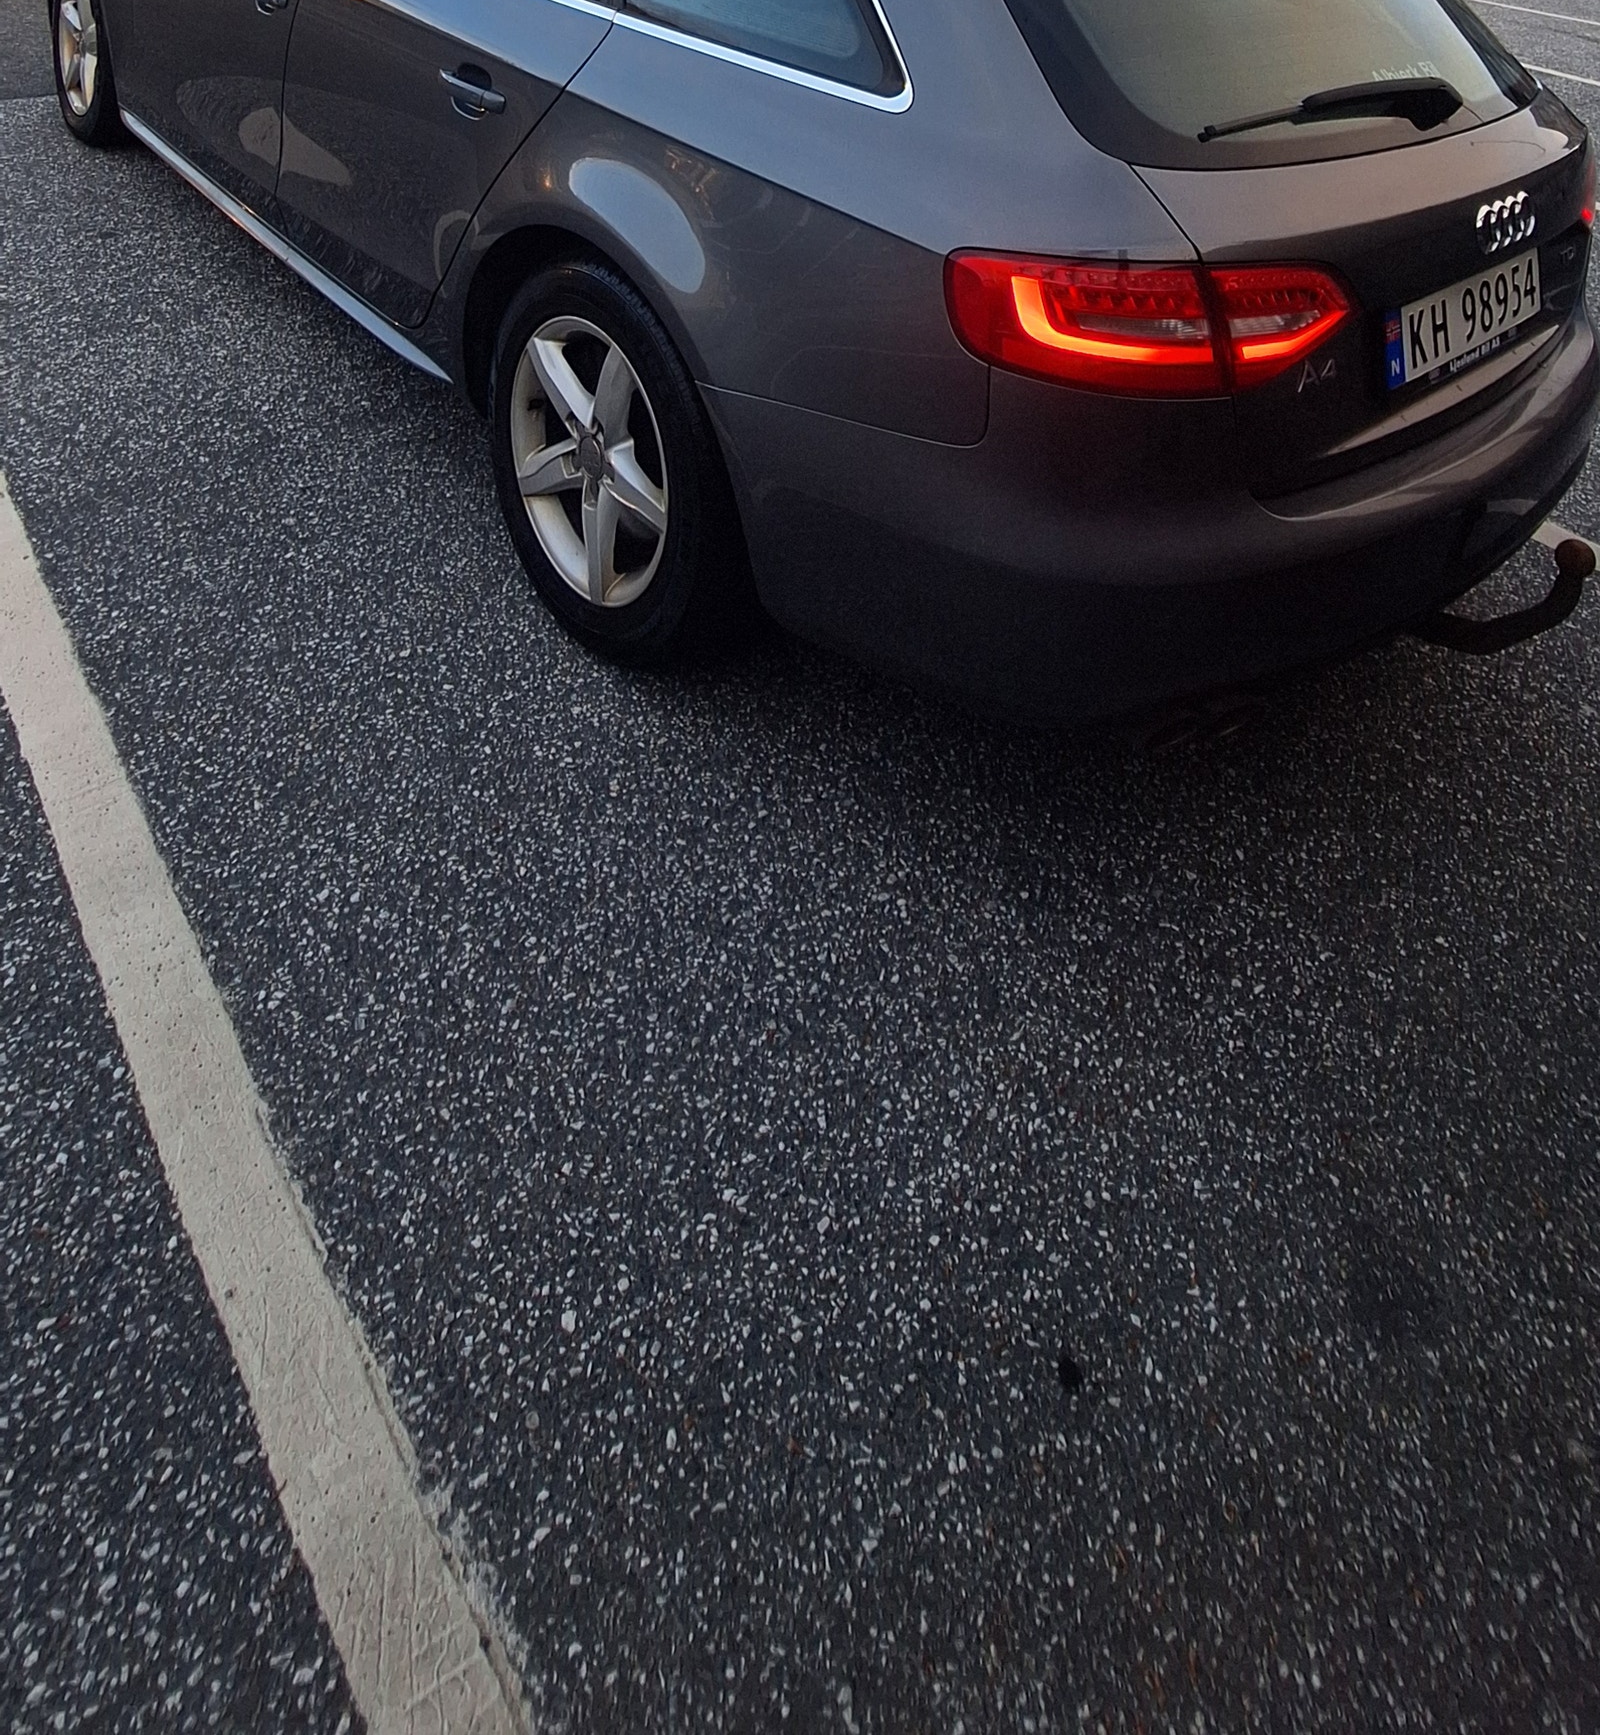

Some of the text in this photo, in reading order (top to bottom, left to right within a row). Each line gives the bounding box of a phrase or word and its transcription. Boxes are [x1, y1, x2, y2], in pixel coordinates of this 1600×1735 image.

[1409, 258, 1537, 369] KH 98954
[1297, 358, 1337, 393] A4
[1390, 358, 1400, 376] N
